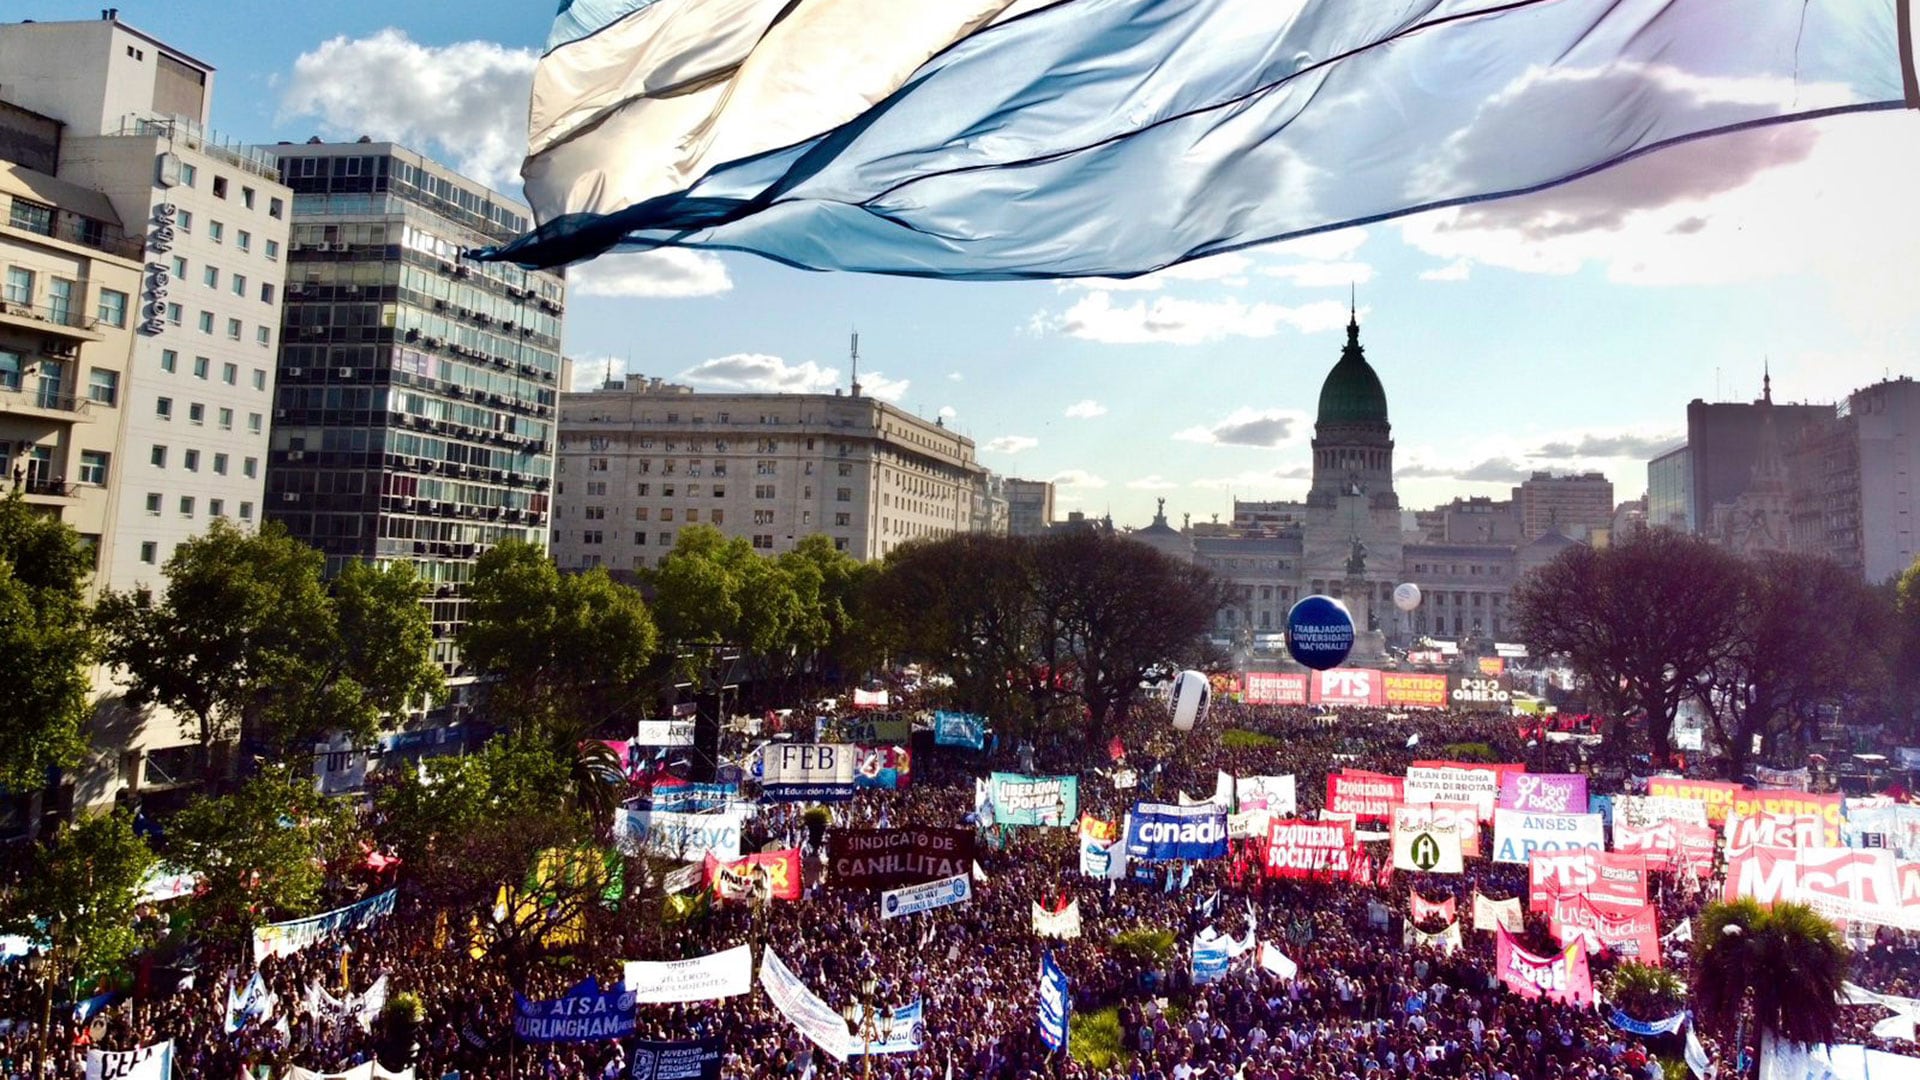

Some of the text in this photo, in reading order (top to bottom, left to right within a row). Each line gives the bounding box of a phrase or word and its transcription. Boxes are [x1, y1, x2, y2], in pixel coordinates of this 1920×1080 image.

[147, 202, 176, 333] hotel ibis
[1321, 671, 1371, 697] PTS
[1385, 677, 1444, 690] PARTIDO
[1460, 678, 1499, 690] POLO
[1387, 689, 1442, 702] OBRERO
[783, 745, 834, 770] FEB
[1413, 770, 1489, 782] PLAN DE LUCHA
[1408, 780, 1494, 791] HASTA DERROTAR
[1434, 792, 1470, 801] A MILEI
[1139, 816, 1225, 844] conadu
[1522, 816, 1577, 831] ANSES
[848, 831, 954, 850] SINDICATO DE
[1272, 825, 1345, 848] IZQUIERDA
[1532, 854, 1598, 887] PTS
